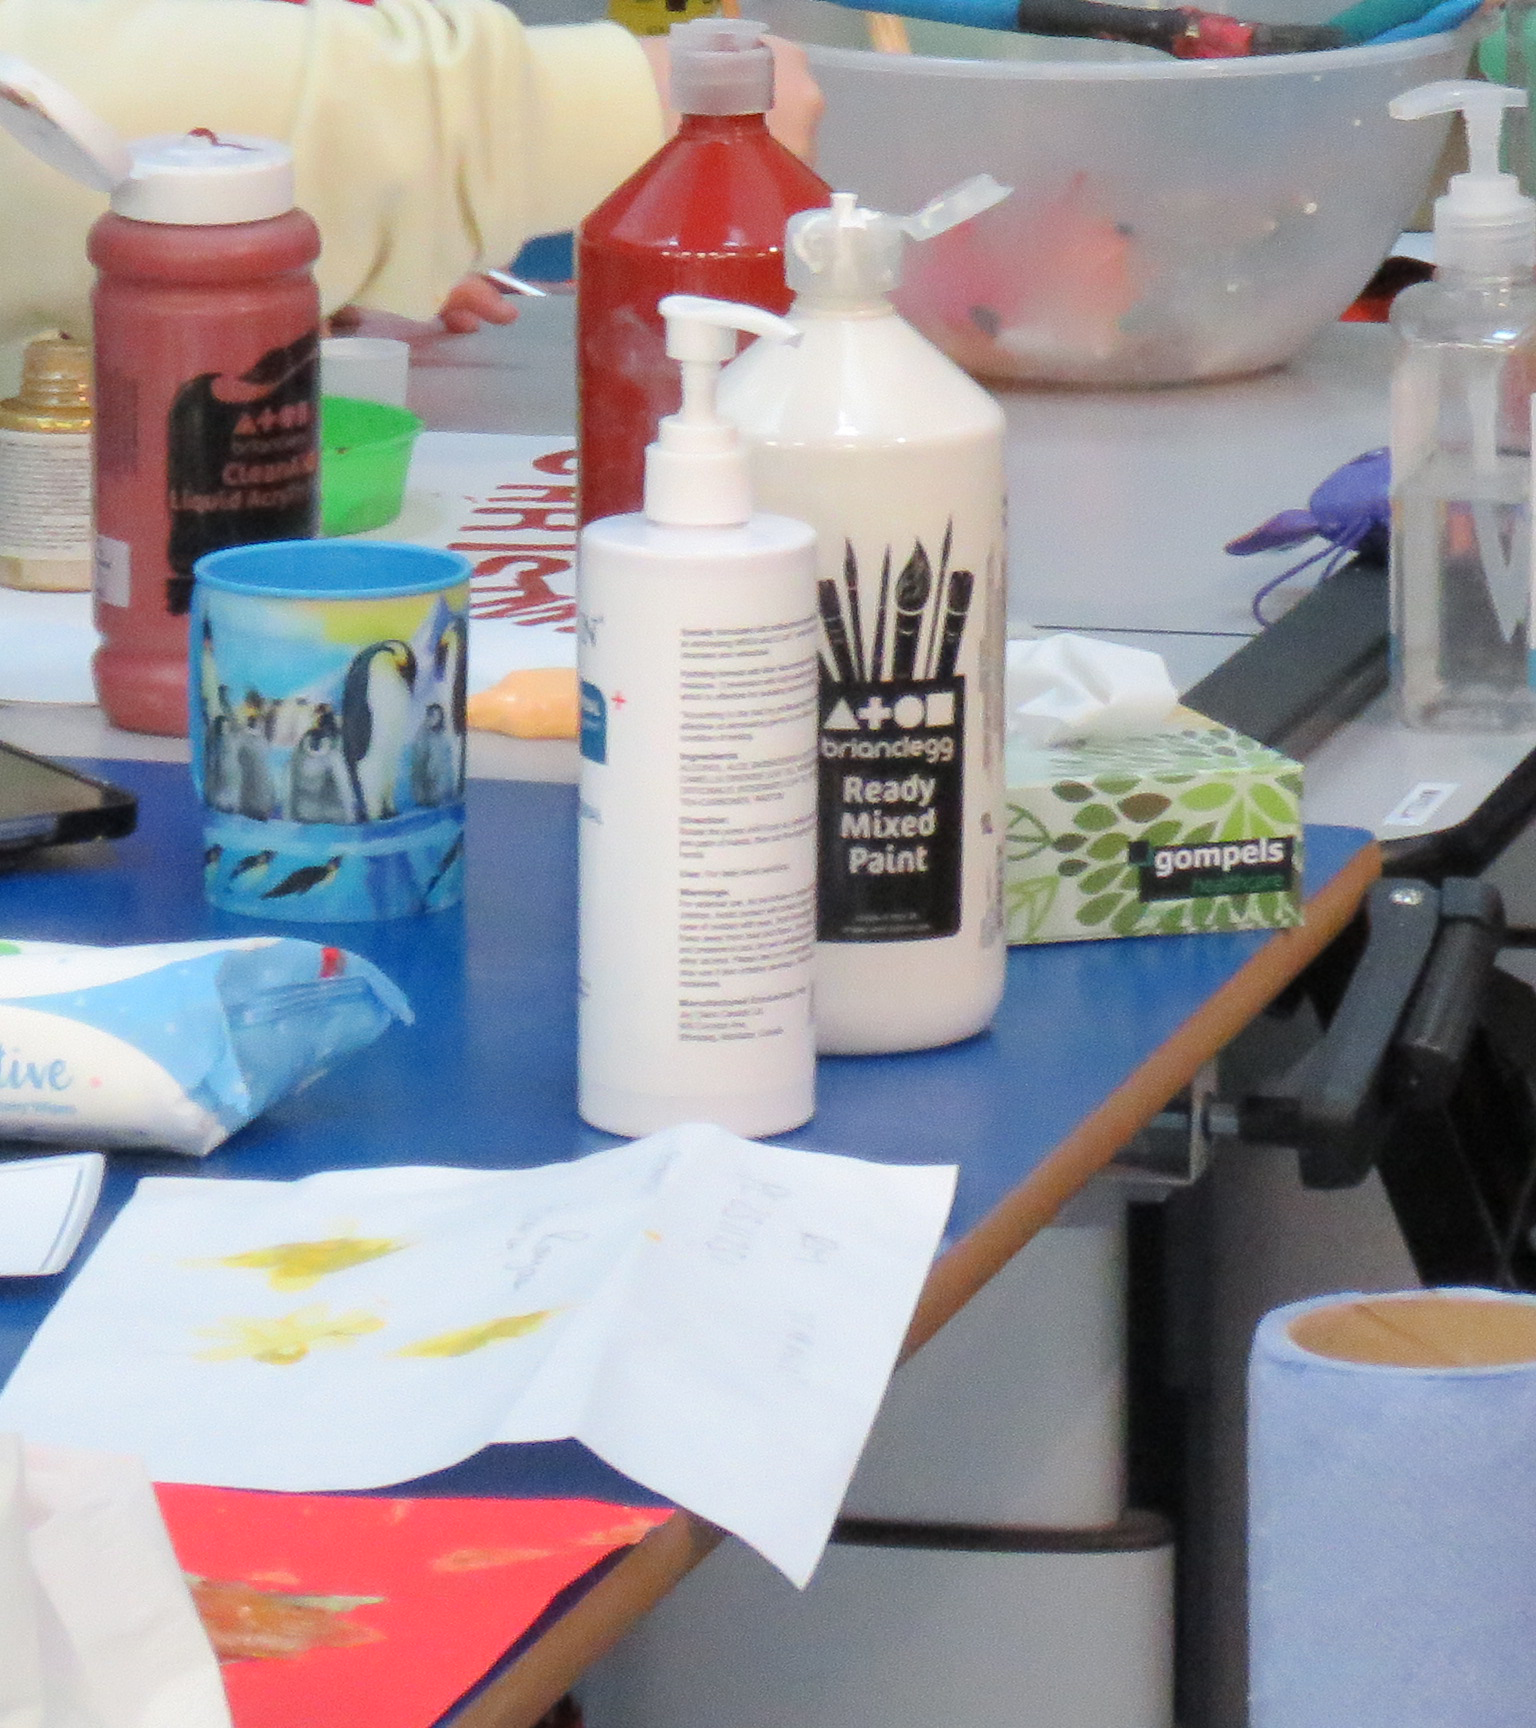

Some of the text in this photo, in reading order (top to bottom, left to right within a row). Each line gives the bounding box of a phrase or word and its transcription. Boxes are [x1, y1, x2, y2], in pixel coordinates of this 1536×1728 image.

[842, 773, 936, 807] Ready
[840, 807, 937, 839] Mixed
[848, 844, 930, 874] Paint
[1155, 837, 1285, 878] gompels
